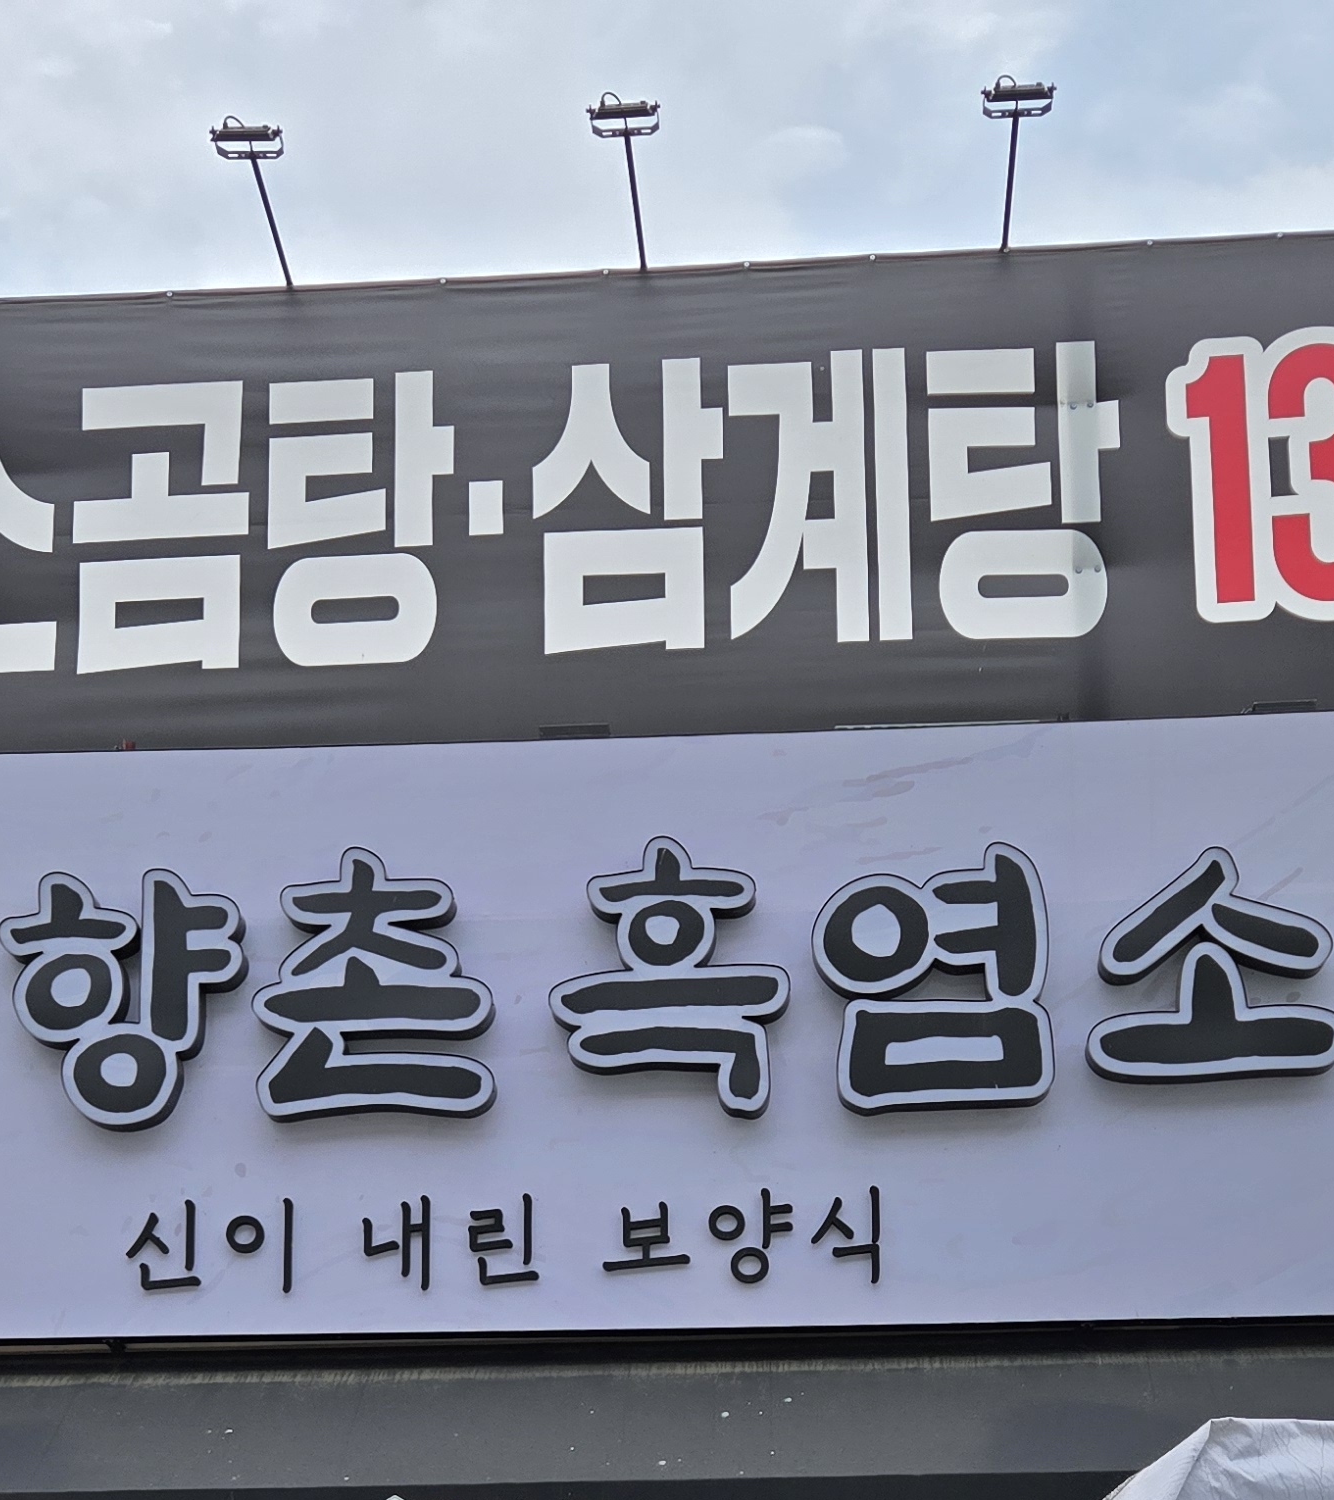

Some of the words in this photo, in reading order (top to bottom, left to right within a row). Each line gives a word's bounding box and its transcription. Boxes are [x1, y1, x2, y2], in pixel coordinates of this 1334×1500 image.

[0, 847, 497, 1131] 향촌
[126, 1197, 294, 1294] 신이
[362, 1194, 540, 1291] 내린
[601, 1186, 882, 1285] 보양식
